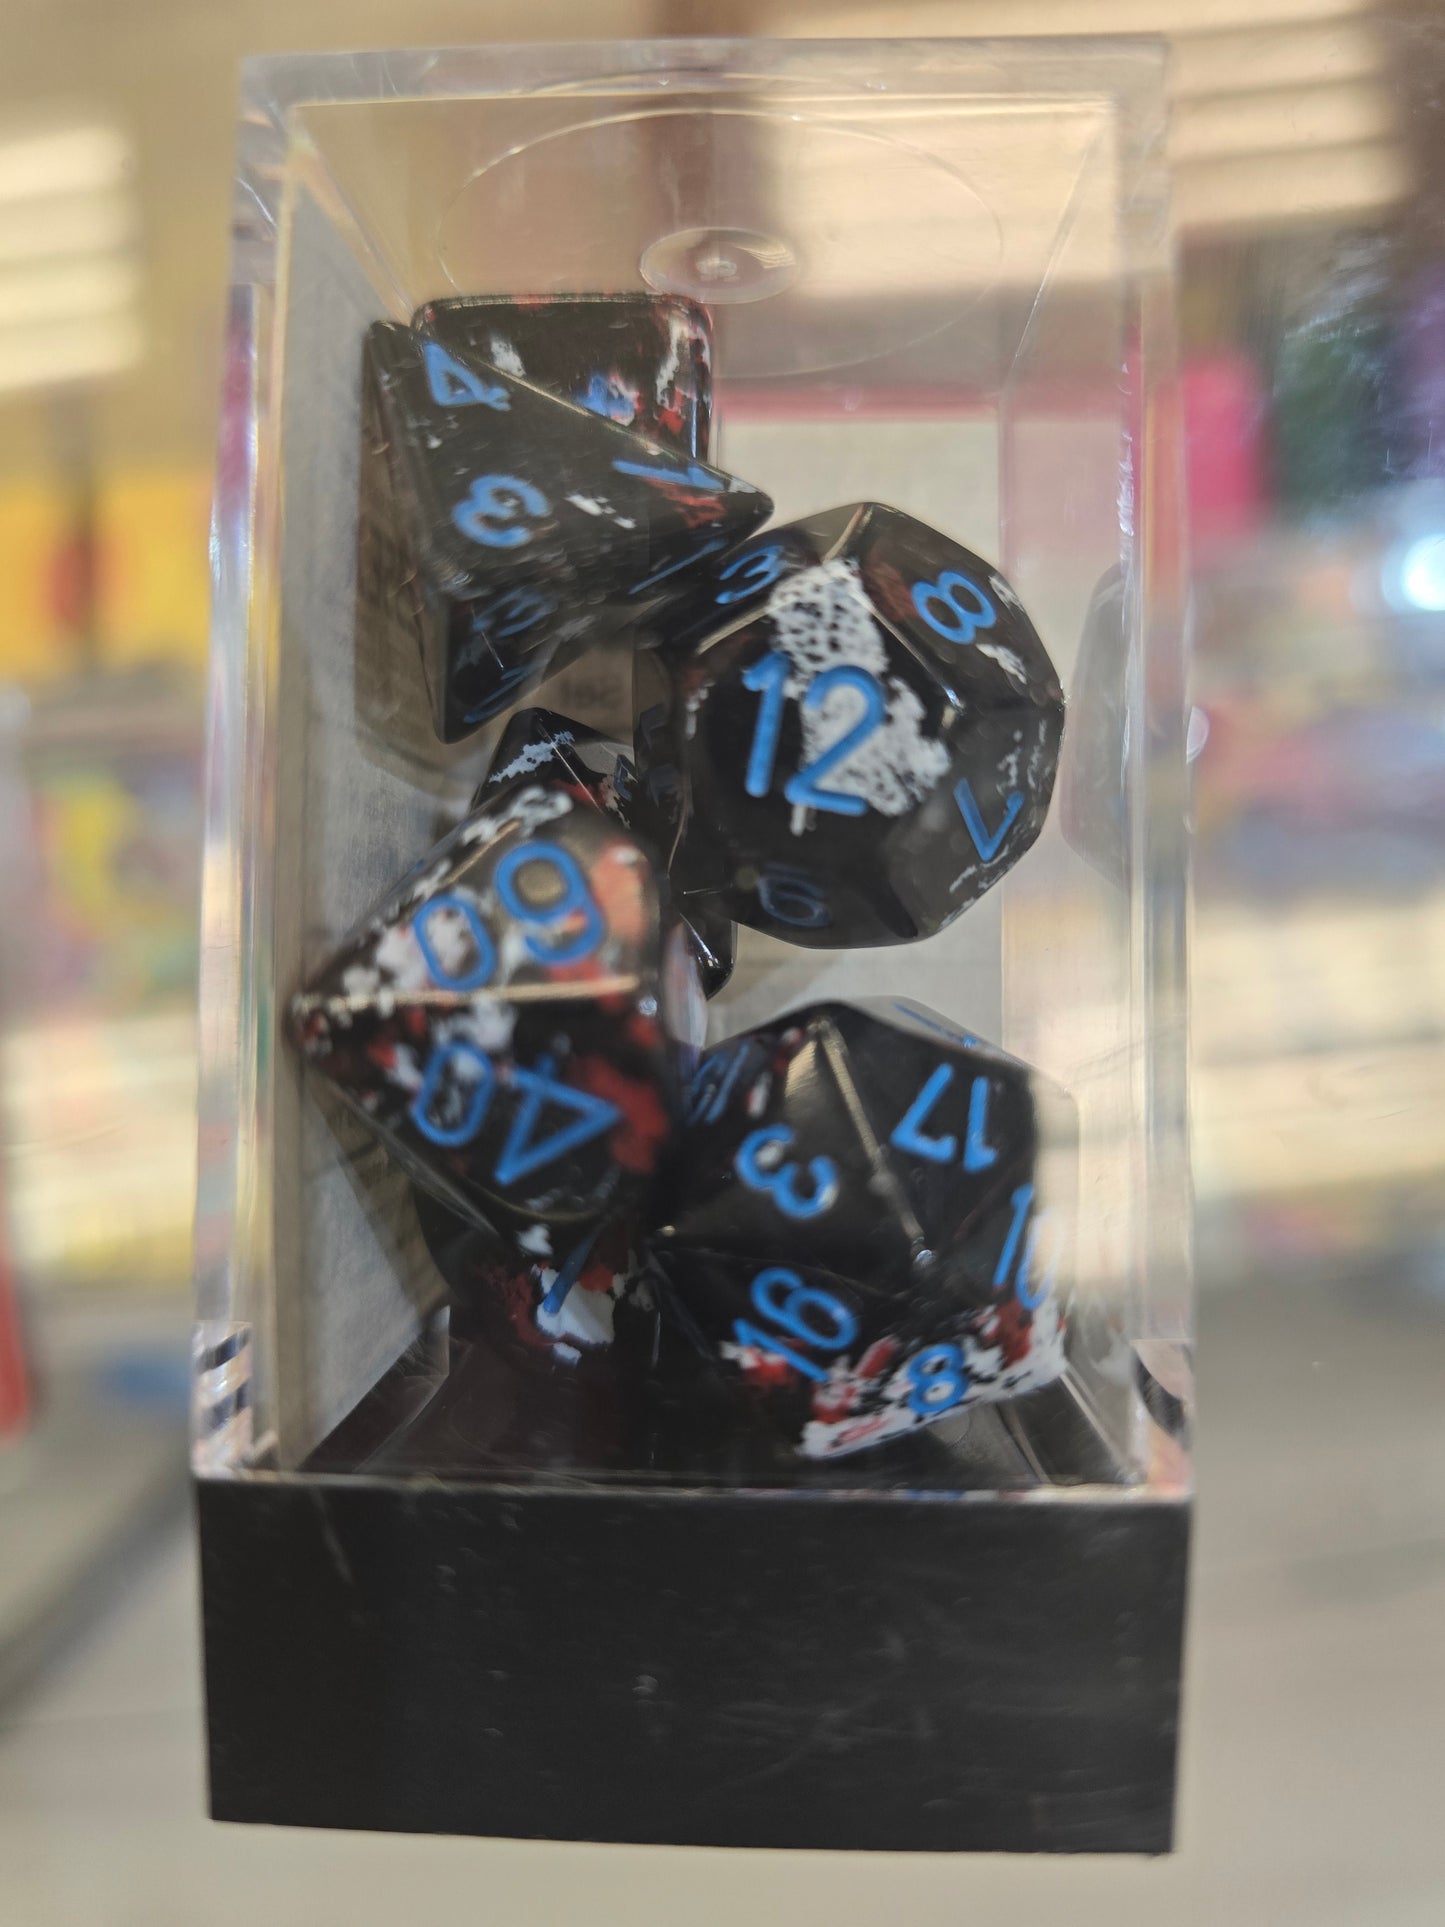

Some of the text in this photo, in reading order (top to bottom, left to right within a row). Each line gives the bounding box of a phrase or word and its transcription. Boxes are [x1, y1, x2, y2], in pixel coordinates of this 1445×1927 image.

[422, 341, 512, 412] 4
[453, 474, 548, 549] 3
[715, 545, 785, 605] 3
[911, 569, 996, 645] 8
[742, 650, 887, 816] 12
[953, 777, 1025, 861] 7
[889, 1062, 997, 1173] 17
[735, 1123, 839, 1219] 3
[733, 1267, 858, 1382] 16
[906, 1342, 970, 1414] 8
